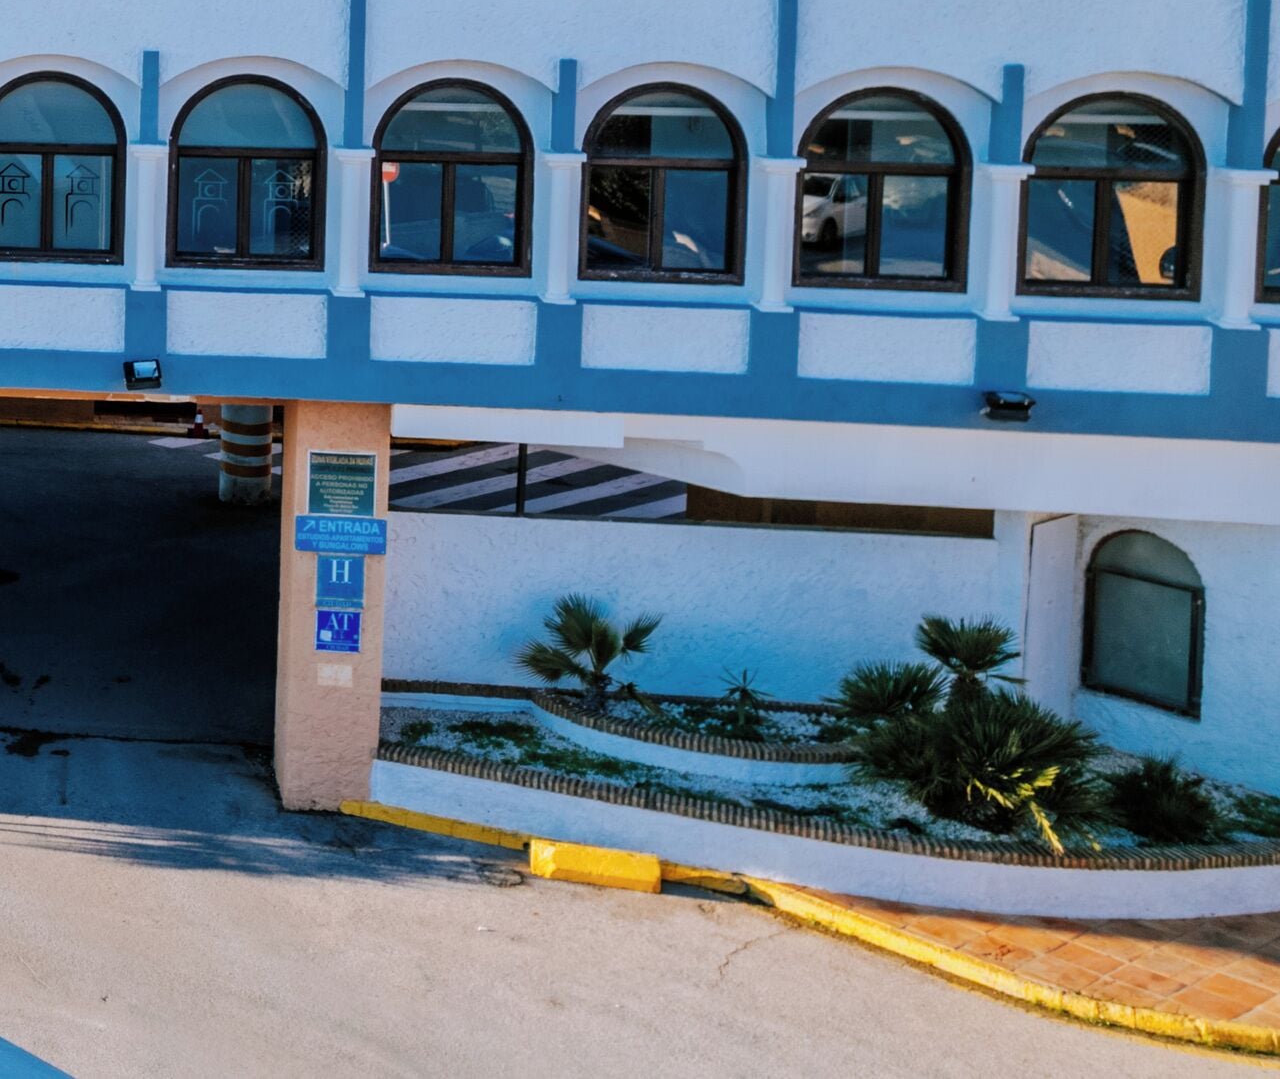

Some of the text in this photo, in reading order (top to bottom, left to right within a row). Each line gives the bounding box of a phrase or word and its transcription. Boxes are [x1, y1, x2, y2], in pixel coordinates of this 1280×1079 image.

[319, 488, 364, 496] AUTORIZADAS
[319, 520, 380, 535] ENTRADA
[318, 541, 369, 551] BUNGALOWS
[329, 558, 352, 584] H
[325, 612, 354, 631] AT
